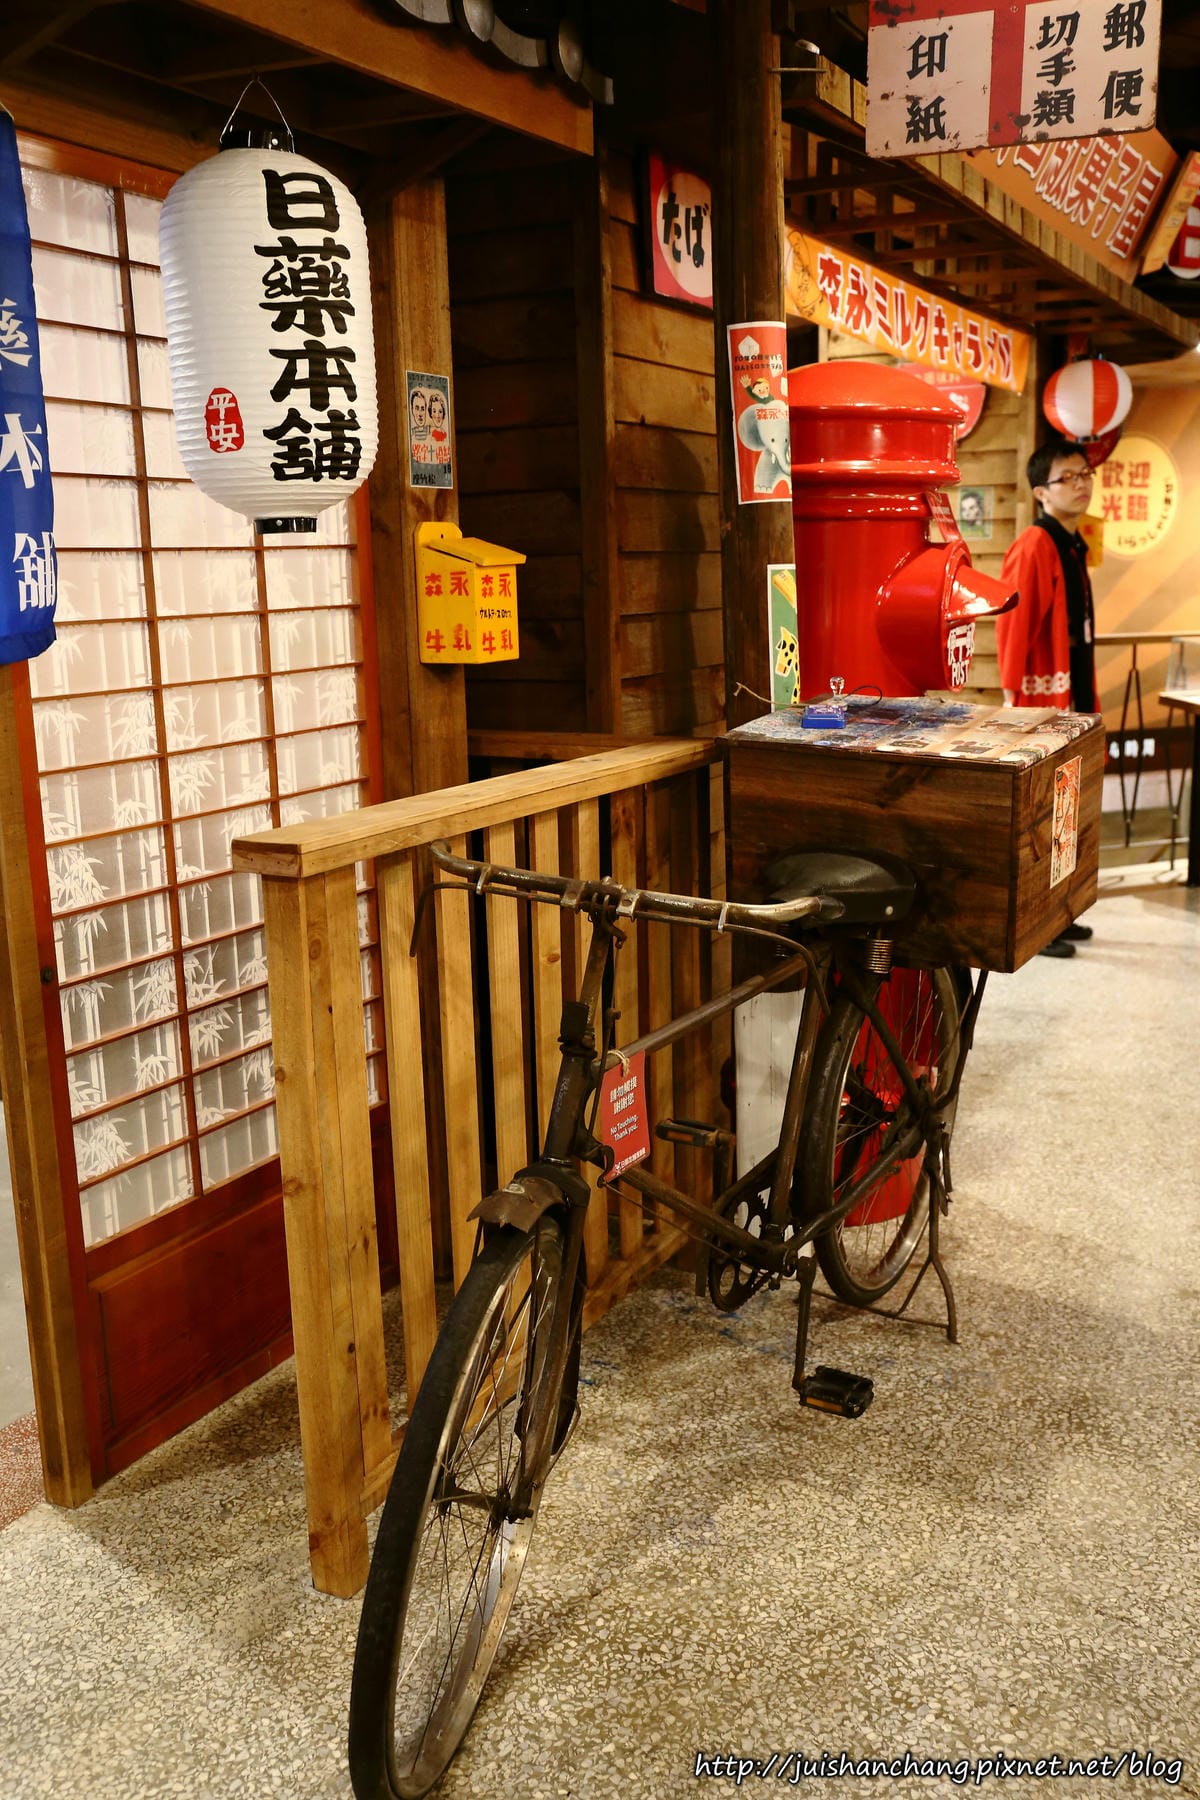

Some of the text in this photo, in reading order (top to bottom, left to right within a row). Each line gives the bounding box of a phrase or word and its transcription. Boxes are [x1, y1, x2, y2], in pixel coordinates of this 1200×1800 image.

[1033, 10, 1080, 127] 切手類
[1098, 0, 1147, 119] 郵便
[905, 32, 949, 144] 印紙
[208, 393, 240, 453] 平安
[425, 571, 469, 597] 森永
[481, 573, 511, 598] 森永
[425, 623, 472, 653] 牛乳
[482, 629, 513, 655] 牛乳
[952, 660, 970, 687] POST
[610, 1126, 617, 1135] No
[614, 1129, 627, 1141] Thank
